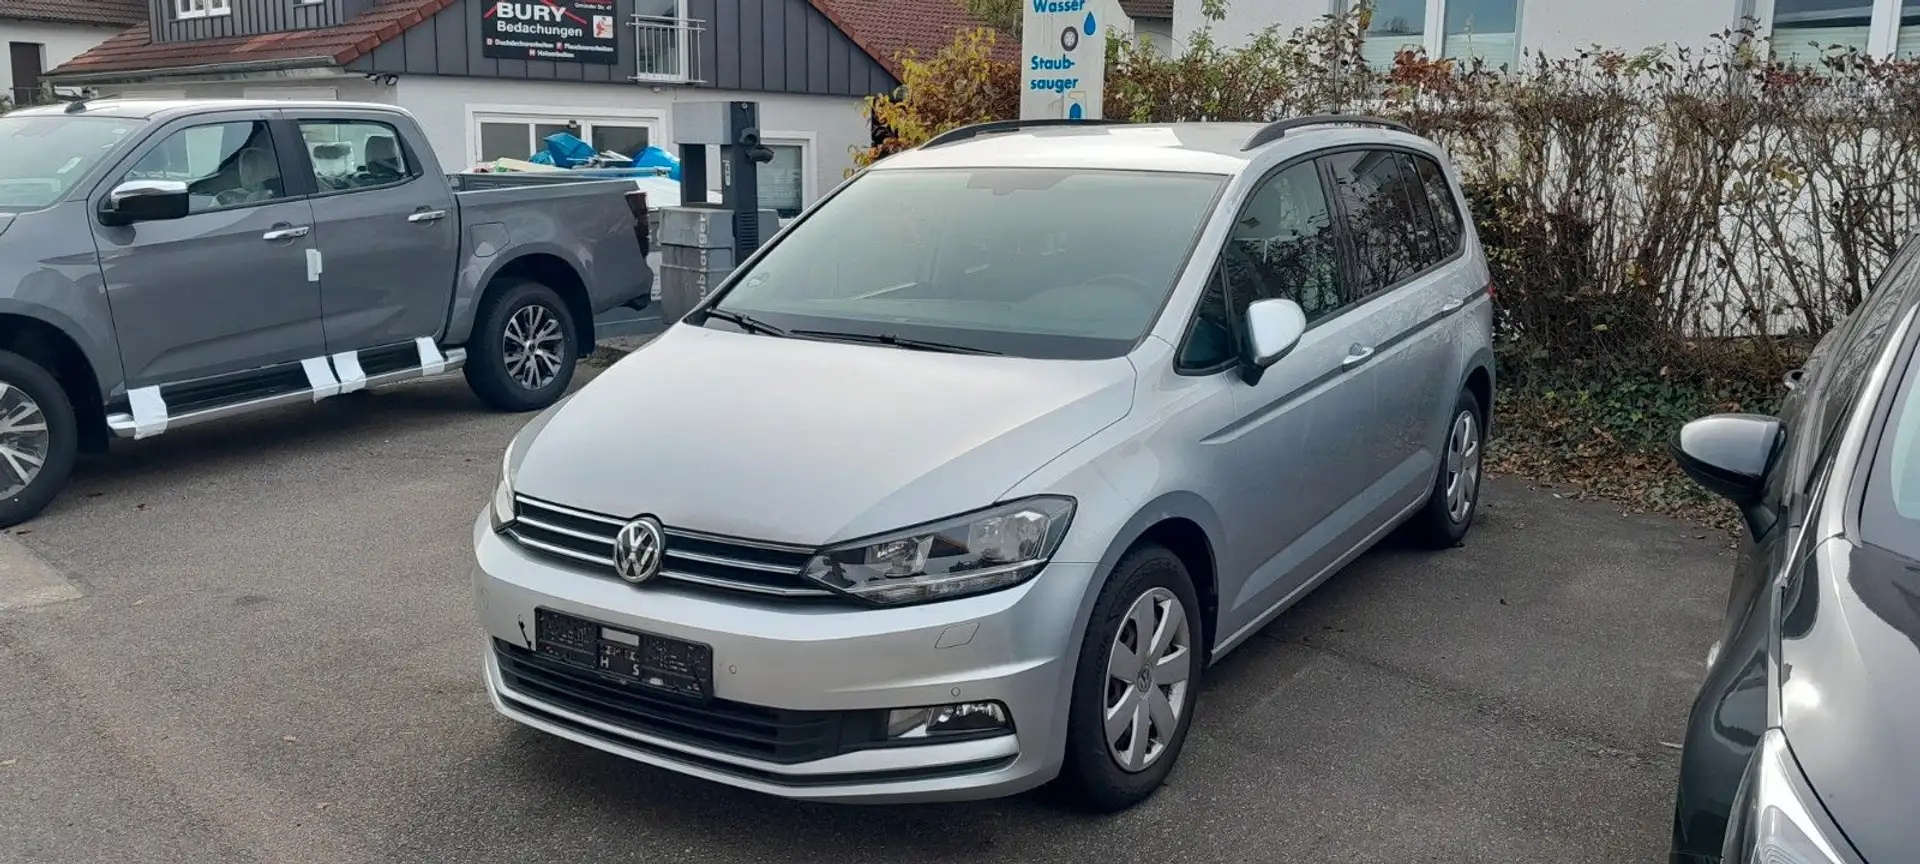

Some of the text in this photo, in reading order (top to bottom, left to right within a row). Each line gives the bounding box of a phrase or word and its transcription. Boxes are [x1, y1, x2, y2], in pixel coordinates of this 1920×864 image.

[496, 2, 567, 22] BURY
[1032, 0, 1086, 13] Wasser
[496, 20, 583, 38] Bedachungen
[1031, 53, 1075, 70] Staub-
[1030, 78, 1079, 94] sauger
